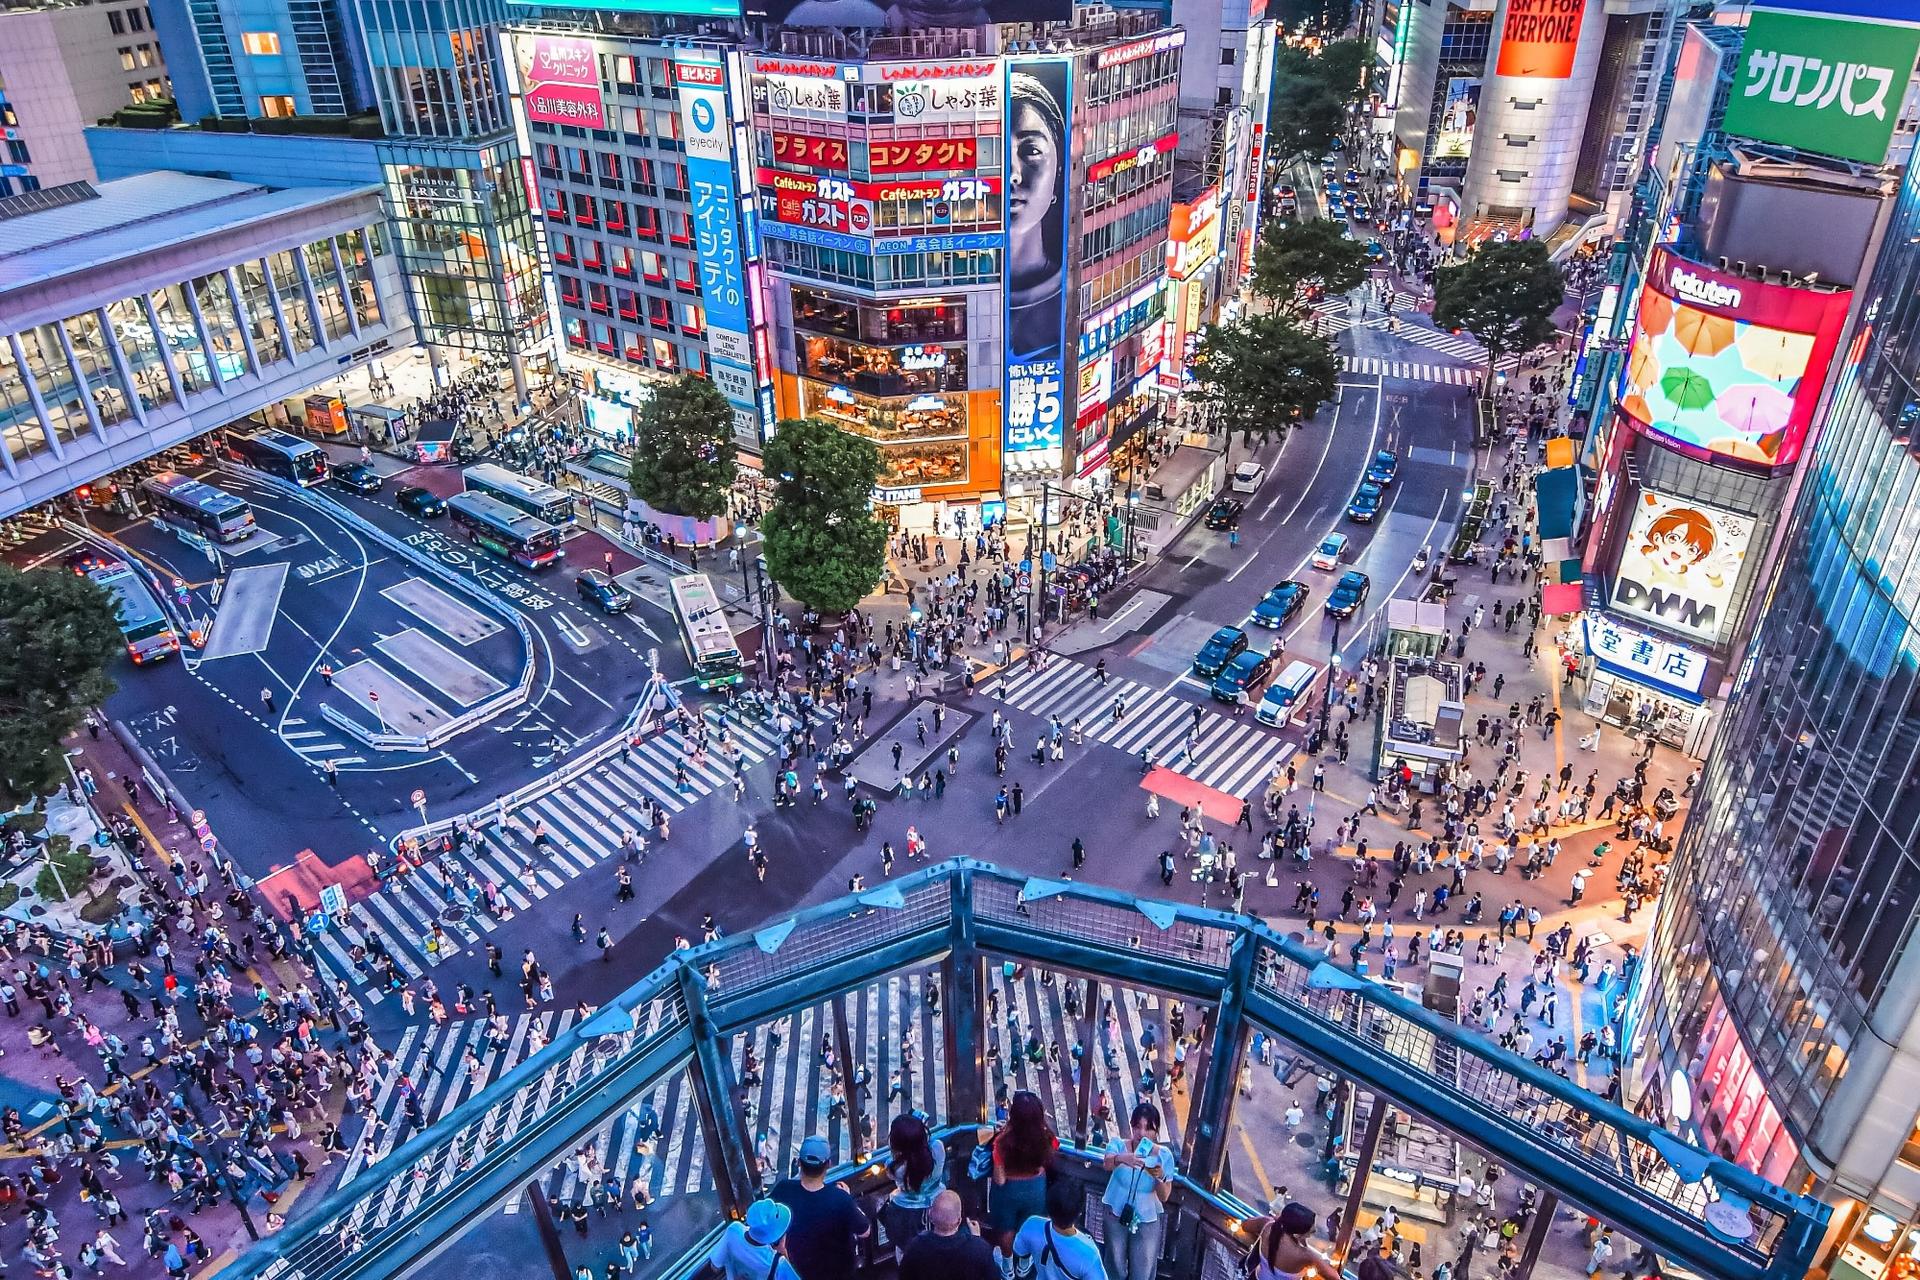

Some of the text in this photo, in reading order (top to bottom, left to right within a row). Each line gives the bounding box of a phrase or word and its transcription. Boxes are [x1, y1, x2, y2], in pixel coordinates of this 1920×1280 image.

[1505, 14, 1577, 43] EVERYONE.
[553, 63, 589, 78] クリニック
[681, 66, 718, 82] 当ビル5F
[753, 86, 767, 100] 9F
[932, 85, 998, 110] しゃぶ葉
[1744, 49, 1894, 122] サロンパス
[537, 96, 599, 120] 品川美容外科
[795, 86, 840, 111] しゃぶ葉
[690, 137, 723, 153] eyecity
[774, 136, 846, 162] プライス
[871, 143, 973, 166] コンタクト
[412, 178, 456, 187] SHIBUYA
[818, 179, 855, 202] ガスト
[942, 179, 991, 202] ガスト
[762, 195, 777, 211] 7F
[802, 200, 845, 227] ガスト
[694, 181, 723, 304] アイシティ
[714, 184, 740, 306] コンタクトの
[880, 236, 1002, 251] AEON 英会話イーオン
[1671, 266, 1742, 308] Rakuten
[716, 333, 740, 344] CONTACT
[1009, 377, 1060, 428] 勝ち
[1009, 424, 1060, 445] にいく
[1616, 577, 1717, 634] DMM
[1591, 624, 1692, 679] 堂書店
